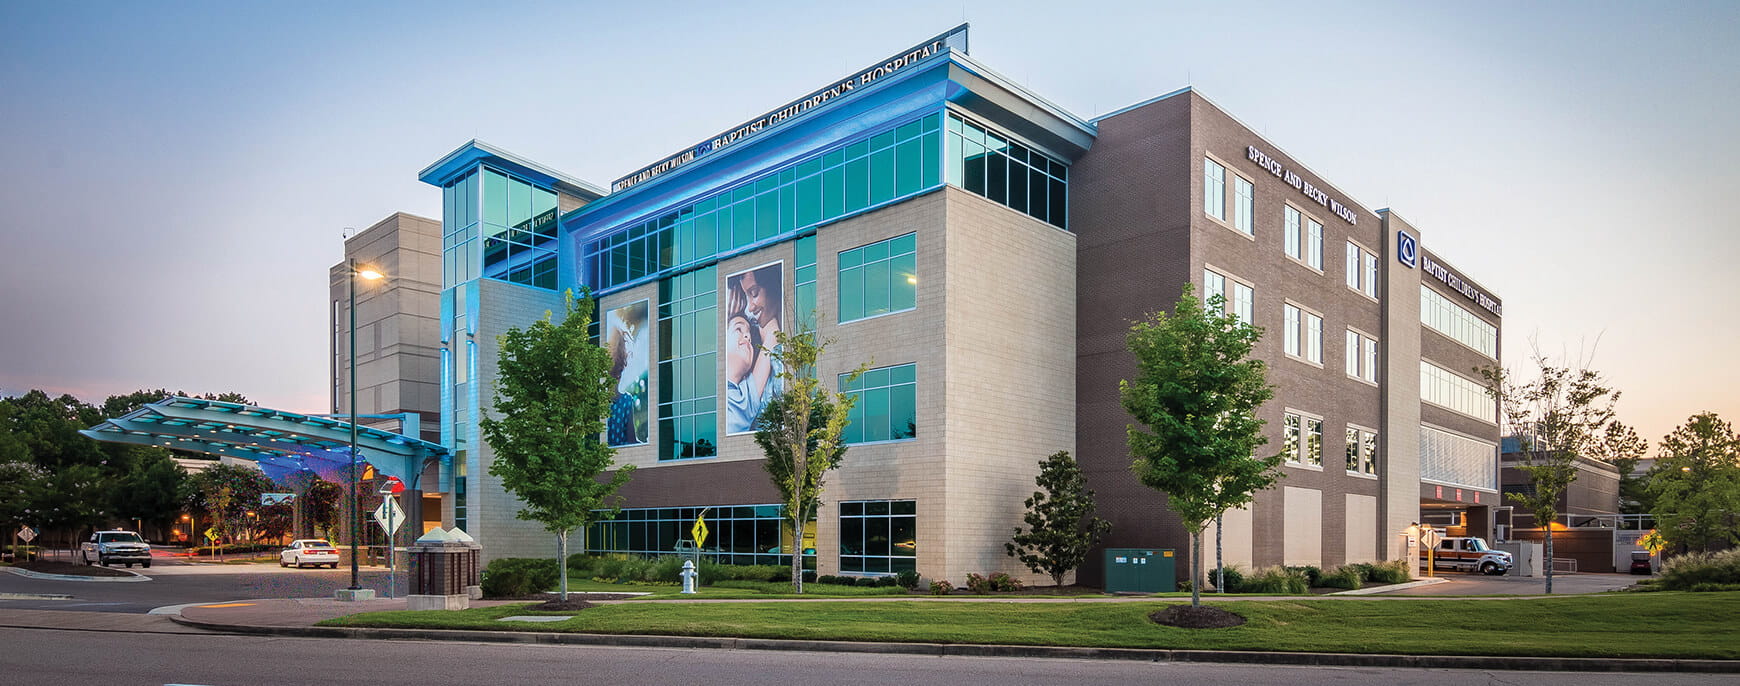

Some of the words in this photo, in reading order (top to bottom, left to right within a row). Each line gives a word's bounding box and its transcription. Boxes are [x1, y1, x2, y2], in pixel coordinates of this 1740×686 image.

[617, 175, 639, 190] SPENCE
[638, 169, 651, 182] AND
[652, 160, 670, 176] BECKY
[671, 150, 694, 168] WILSON
[712, 118, 766, 150] BAPTIST
[1248, 145, 1282, 178] SPENCE
[1284, 169, 1302, 189] AND
[1303, 181, 1329, 207] BECKY
[1330, 198, 1357, 225] WILSON
[1423, 256, 1447, 283] BAPTIST
